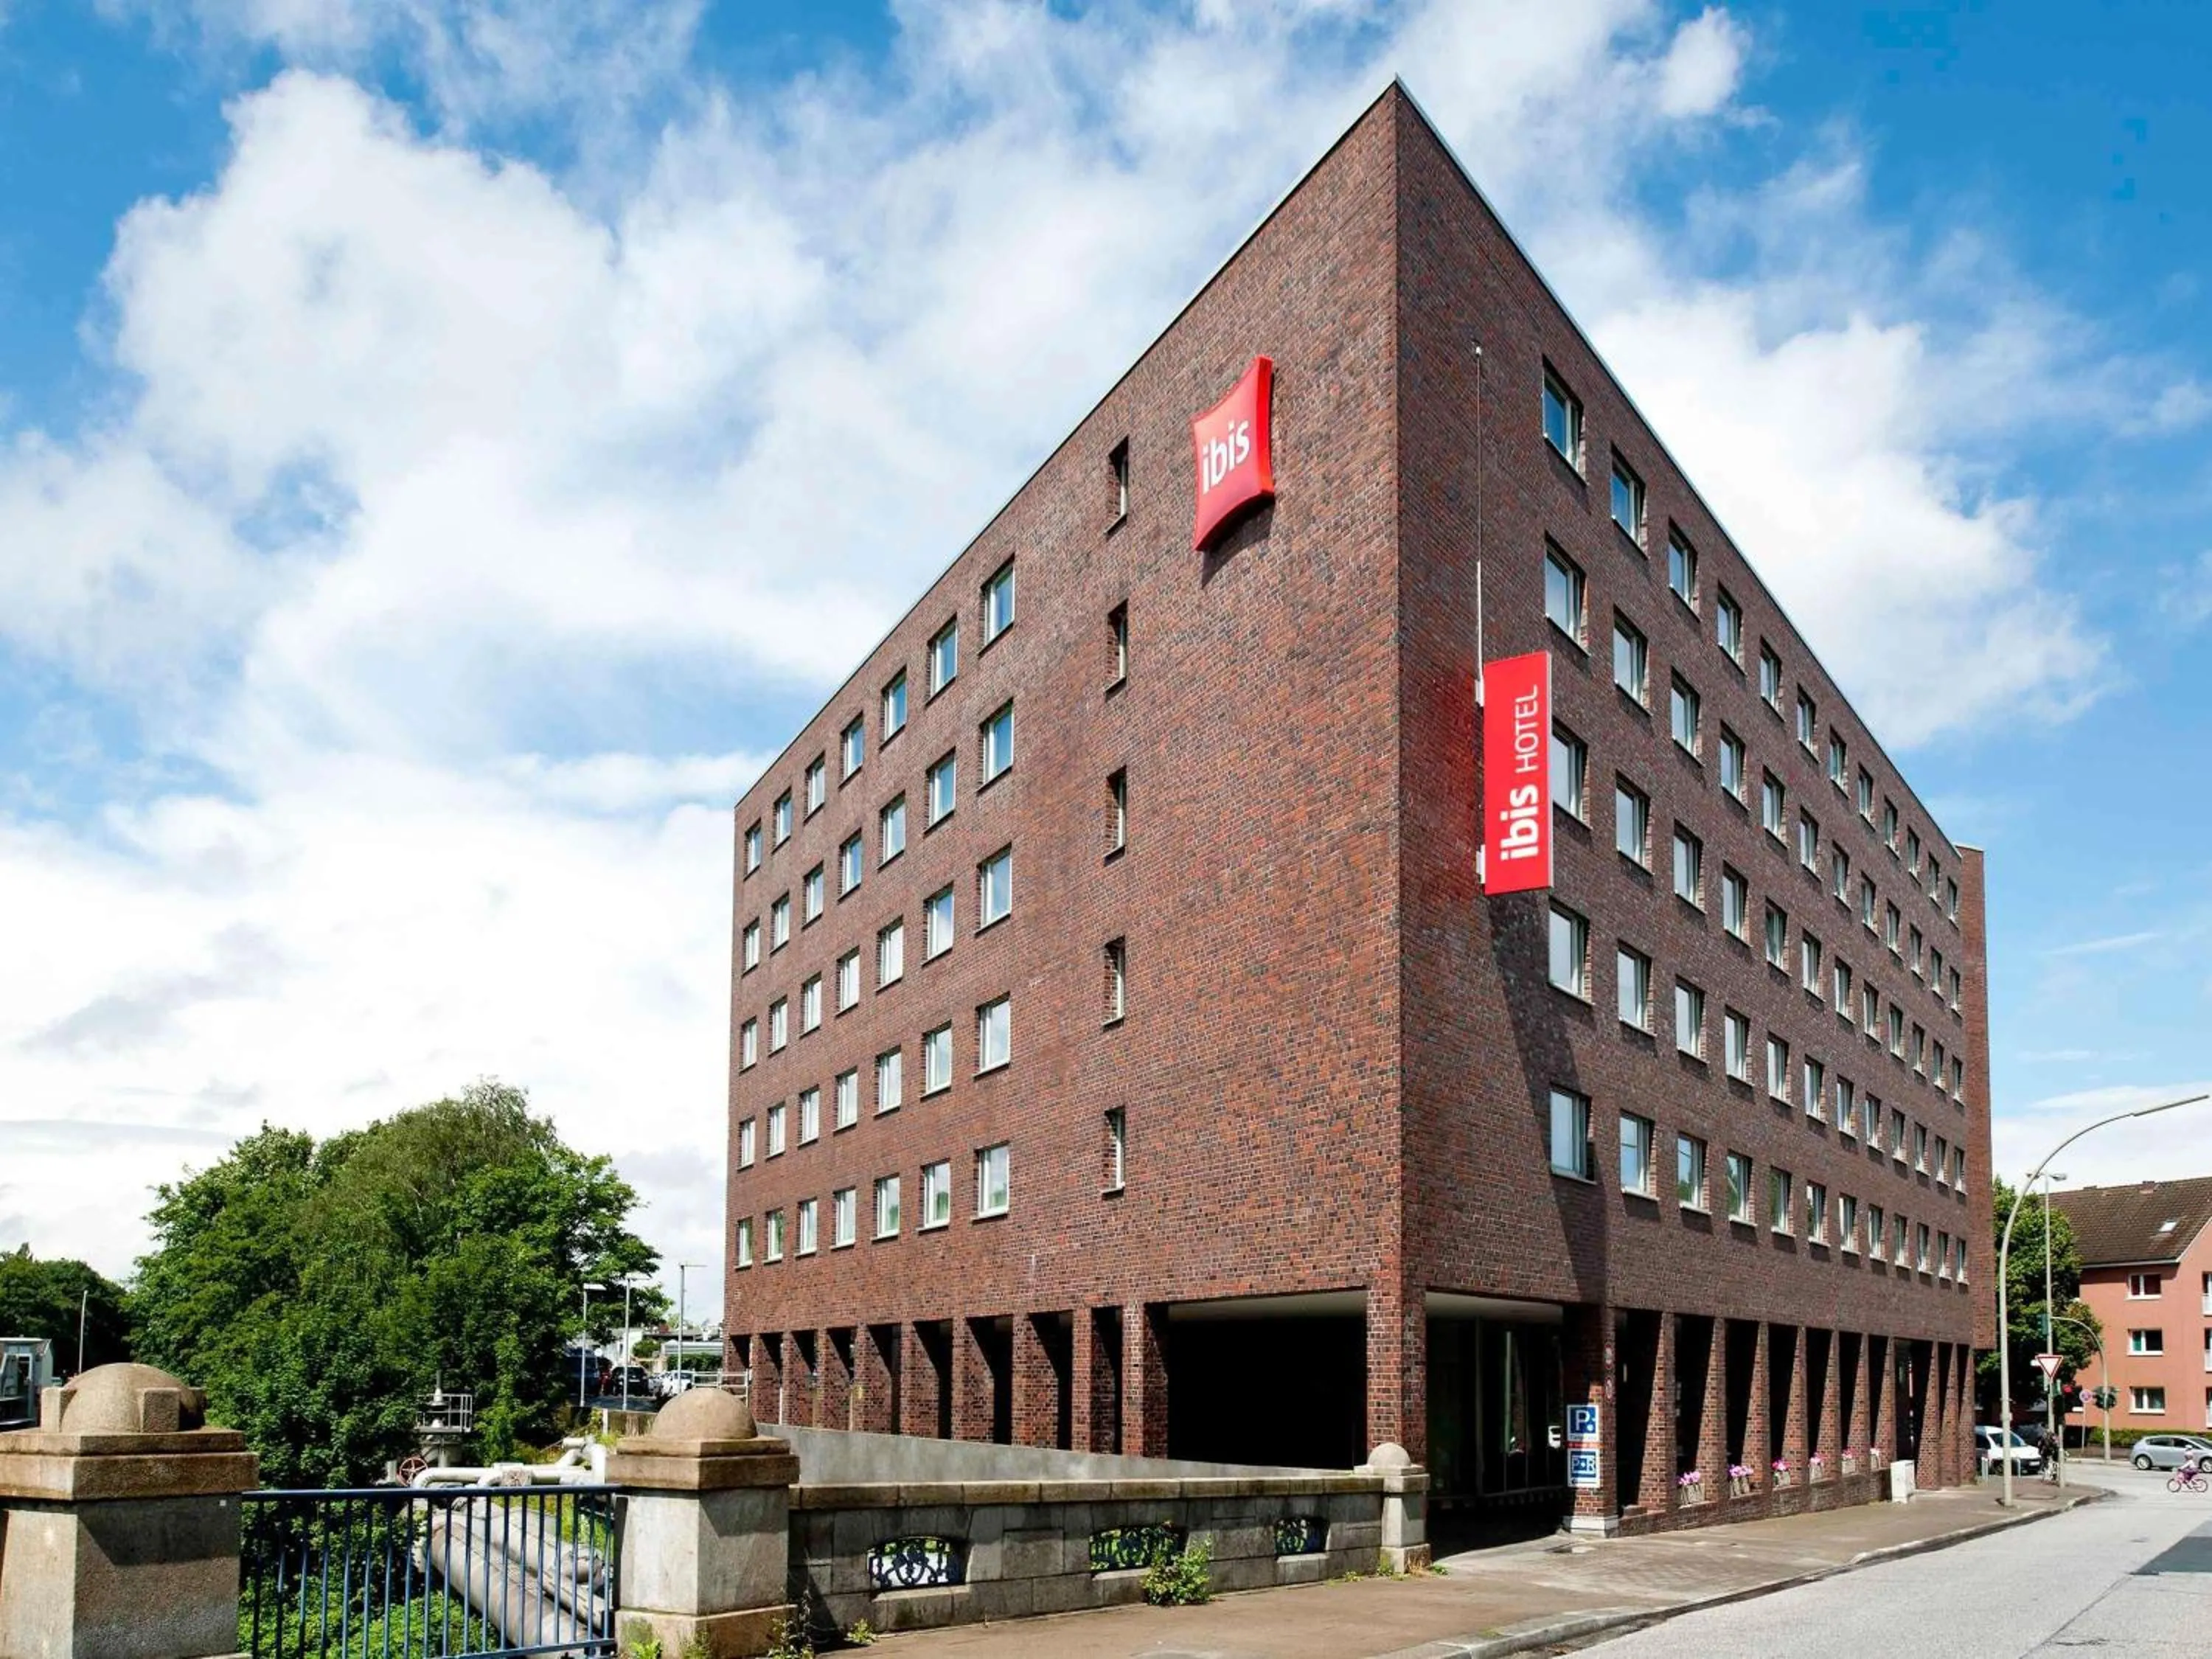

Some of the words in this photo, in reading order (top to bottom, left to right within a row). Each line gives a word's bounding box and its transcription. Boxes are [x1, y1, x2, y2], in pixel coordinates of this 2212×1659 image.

[1202, 419, 1250, 495] ibis
[1514, 684, 1539, 774] HOTEL
[1500, 784, 1539, 861] ibis
